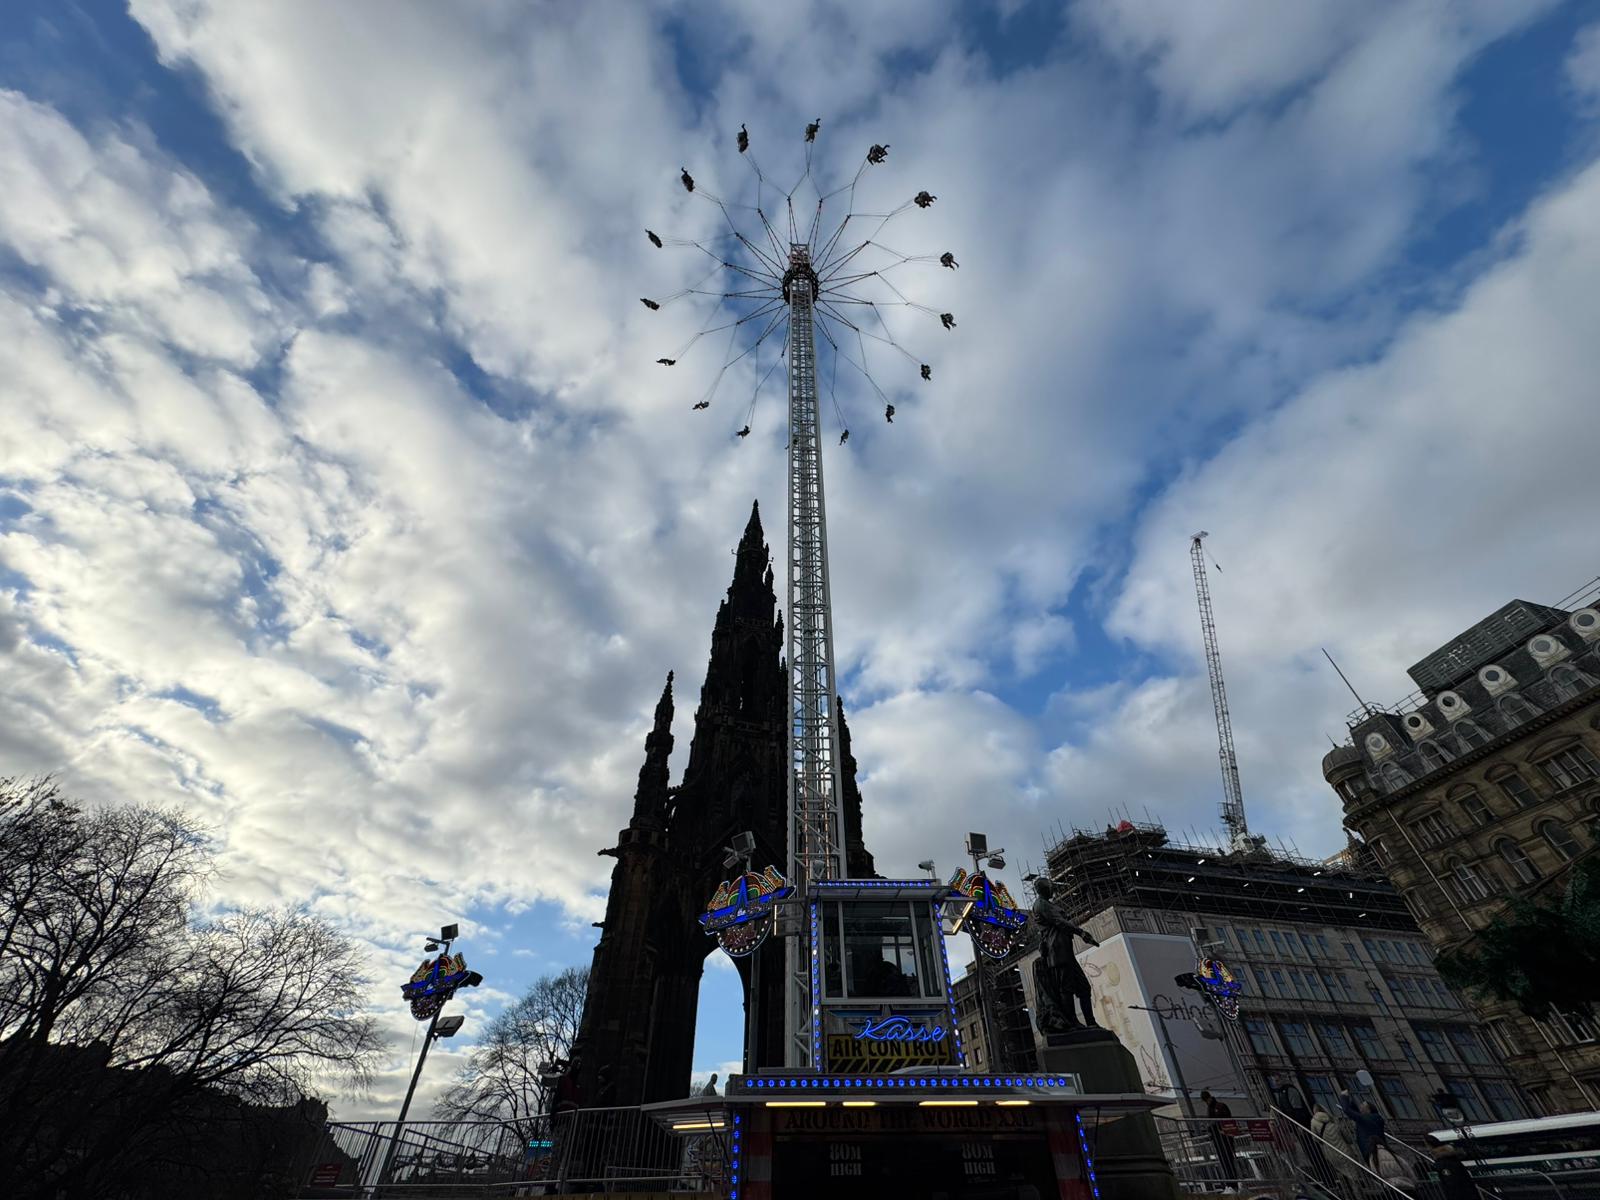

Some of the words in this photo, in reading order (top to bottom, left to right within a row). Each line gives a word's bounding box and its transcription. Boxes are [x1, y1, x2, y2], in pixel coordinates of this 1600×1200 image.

[854, 1015, 948, 1041] Kasse
[832, 1038, 862, 1057] AIR
[868, 1039, 947, 1057] CONTROL
[784, 1110, 869, 1128] AROUND
[921, 1109, 992, 1128] WORLD
[830, 1162, 863, 1177] HIGH
[964, 1161, 997, 1176] HIGH
